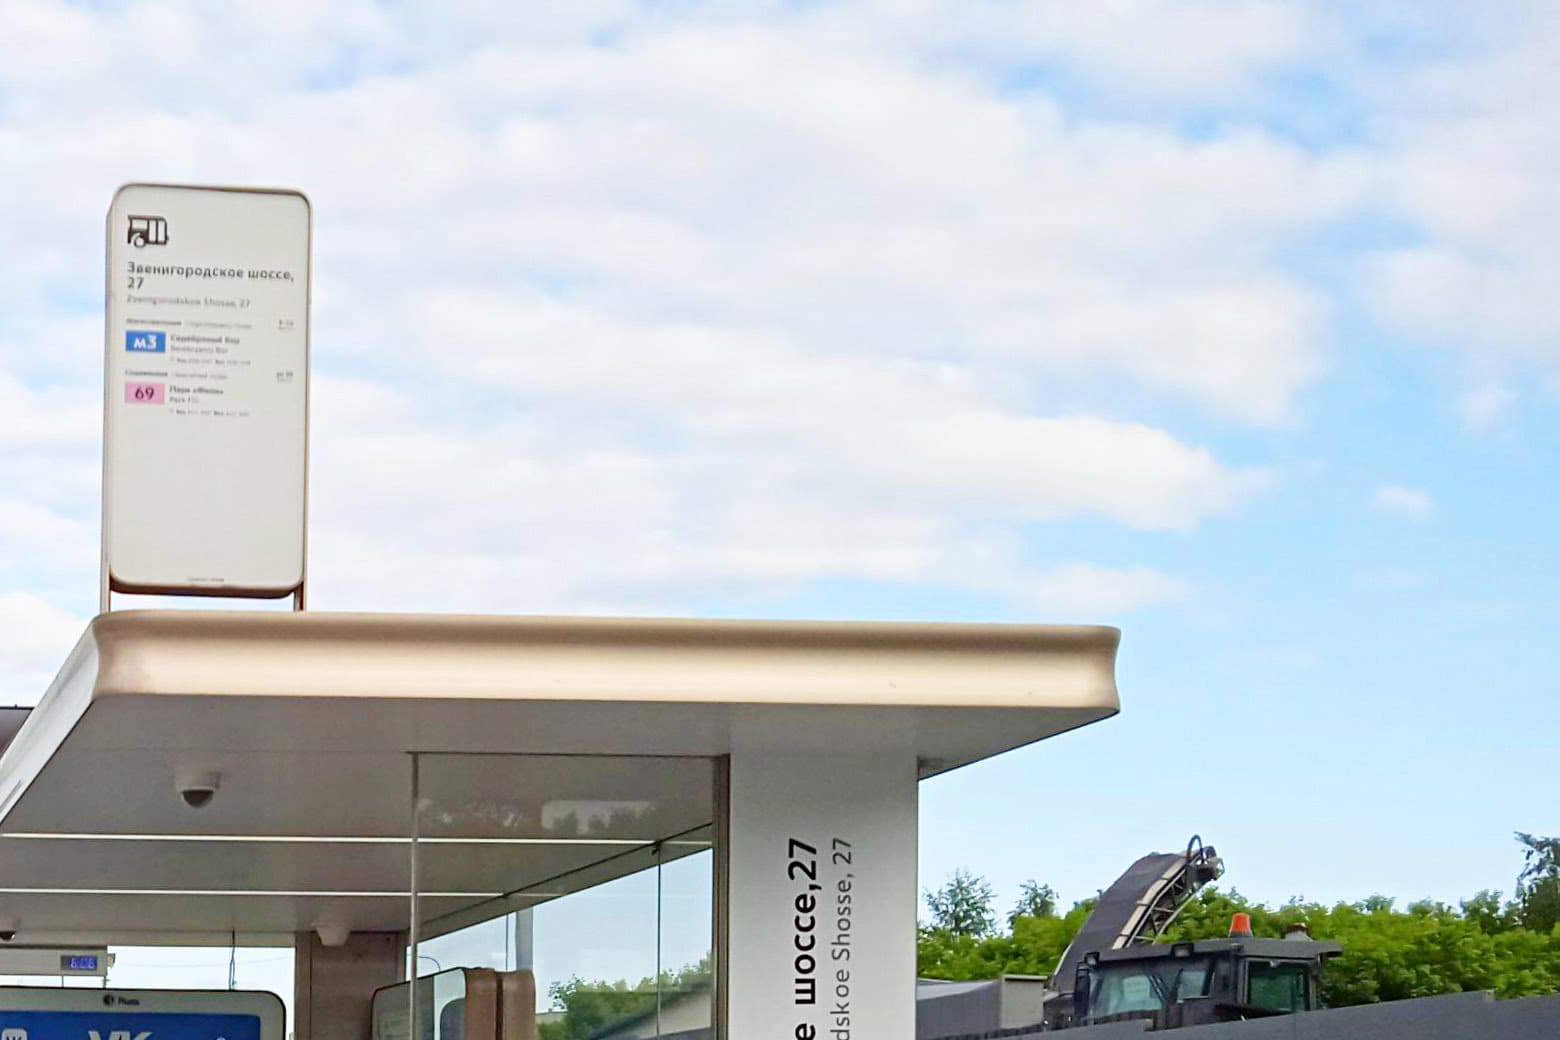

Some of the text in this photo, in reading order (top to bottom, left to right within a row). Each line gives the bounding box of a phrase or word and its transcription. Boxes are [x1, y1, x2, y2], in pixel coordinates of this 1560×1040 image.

[127, 261, 295, 283] Звенигородское шоссе,
[127, 277, 144, 289] 27
[135, 387, 155, 400] 69
[831, 837, 853, 864] 27
[831, 872, 857, 962] Shosse,
